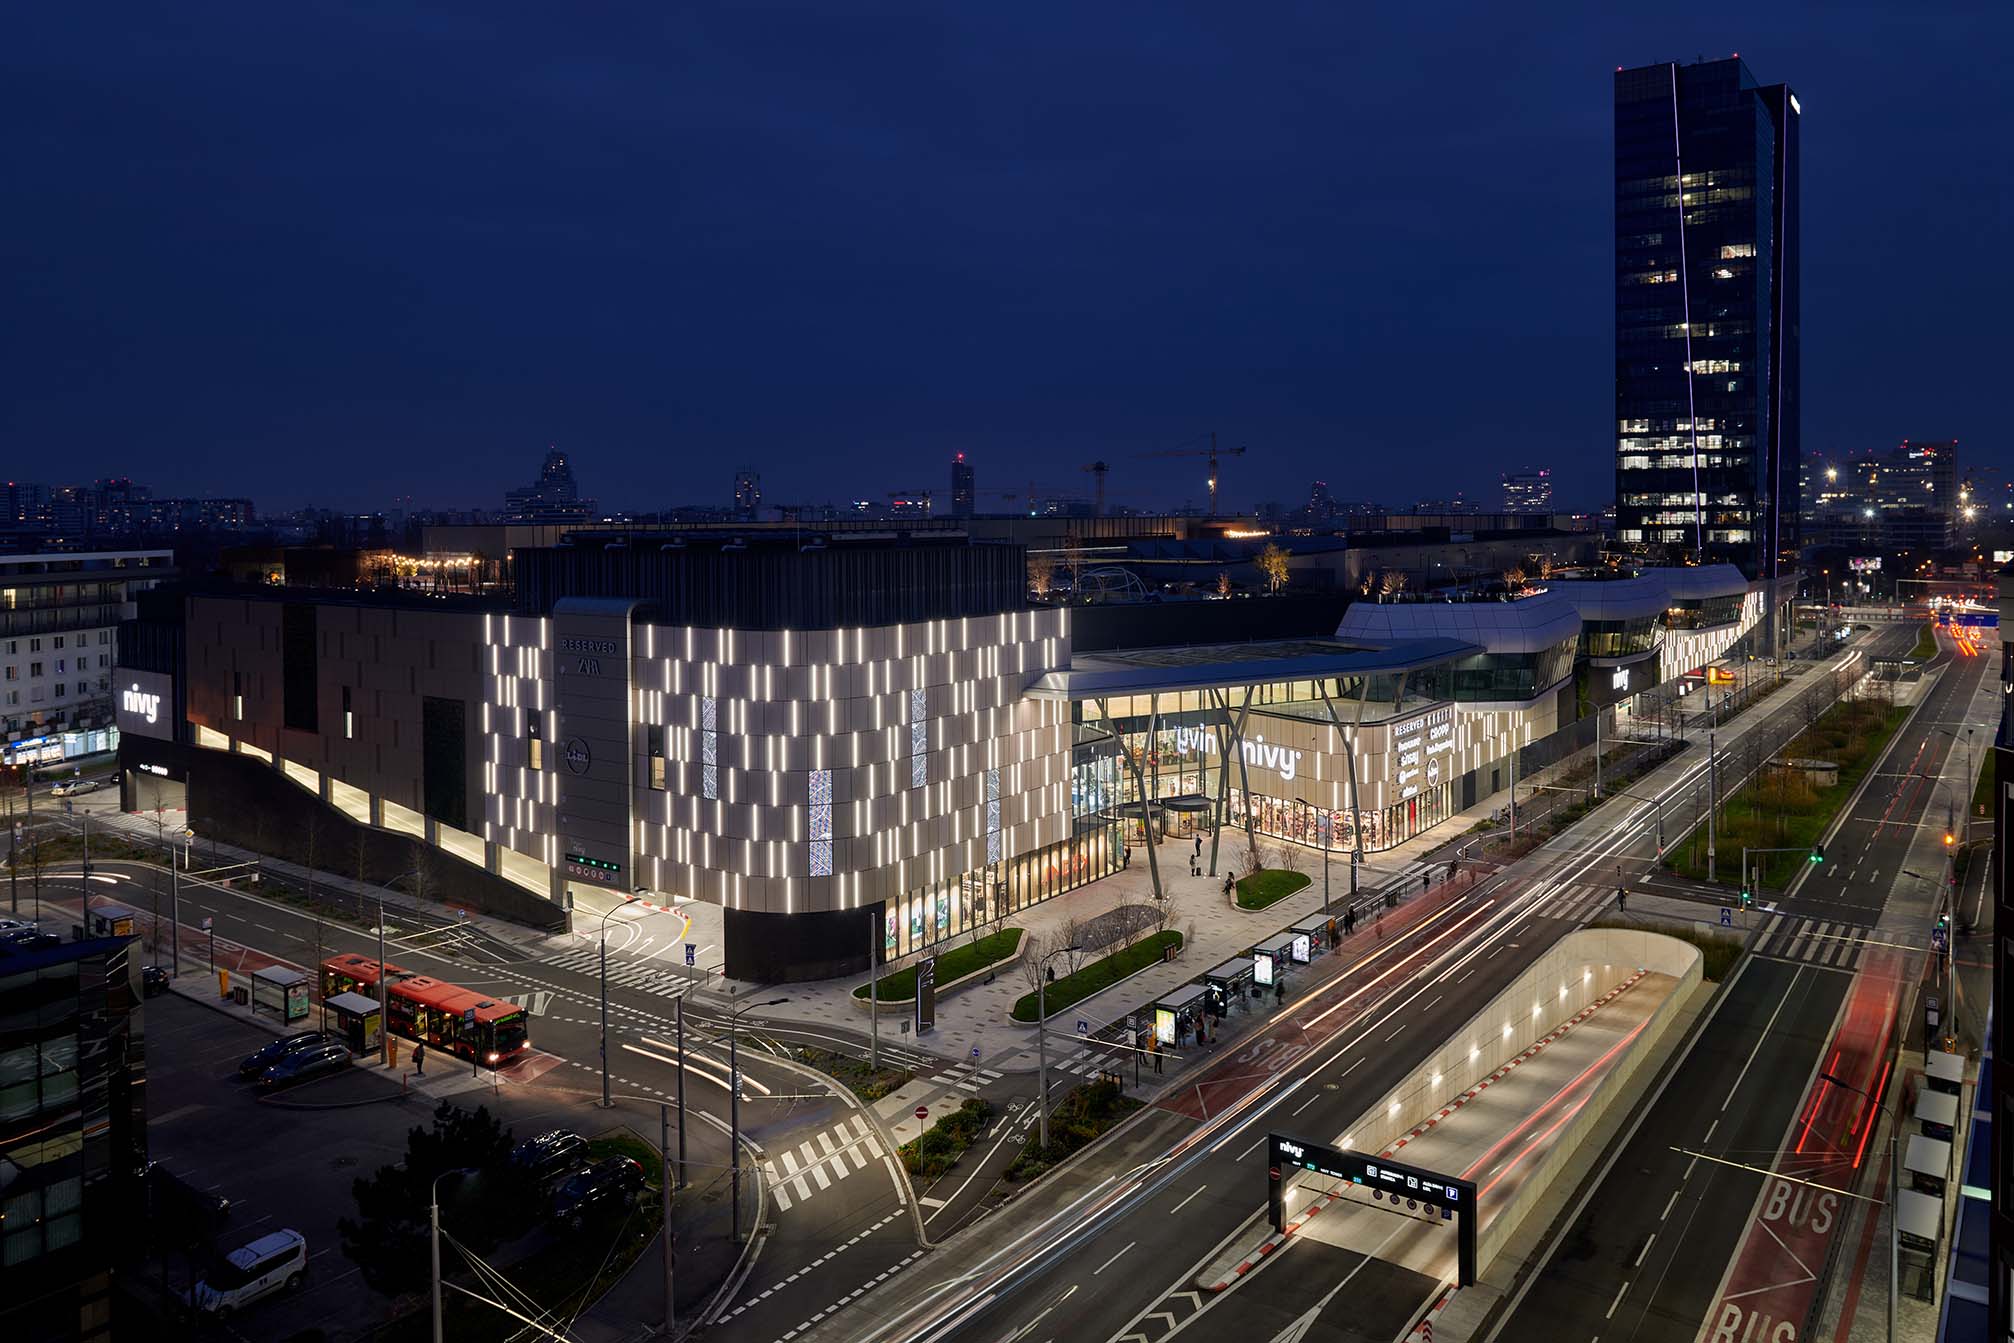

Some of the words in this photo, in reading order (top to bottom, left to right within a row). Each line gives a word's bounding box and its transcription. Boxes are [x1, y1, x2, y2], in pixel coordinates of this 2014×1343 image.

[562, 639, 617, 654] RESERVED
[1613, 666, 1630, 691] nivy
[123, 683, 161, 724] nivy
[1395, 718, 1424, 737] RESERVED
[1242, 734, 1302, 781] nivy
[1279, 1141, 1304, 1158] nivy
[1763, 1180, 1838, 1234] BUS
